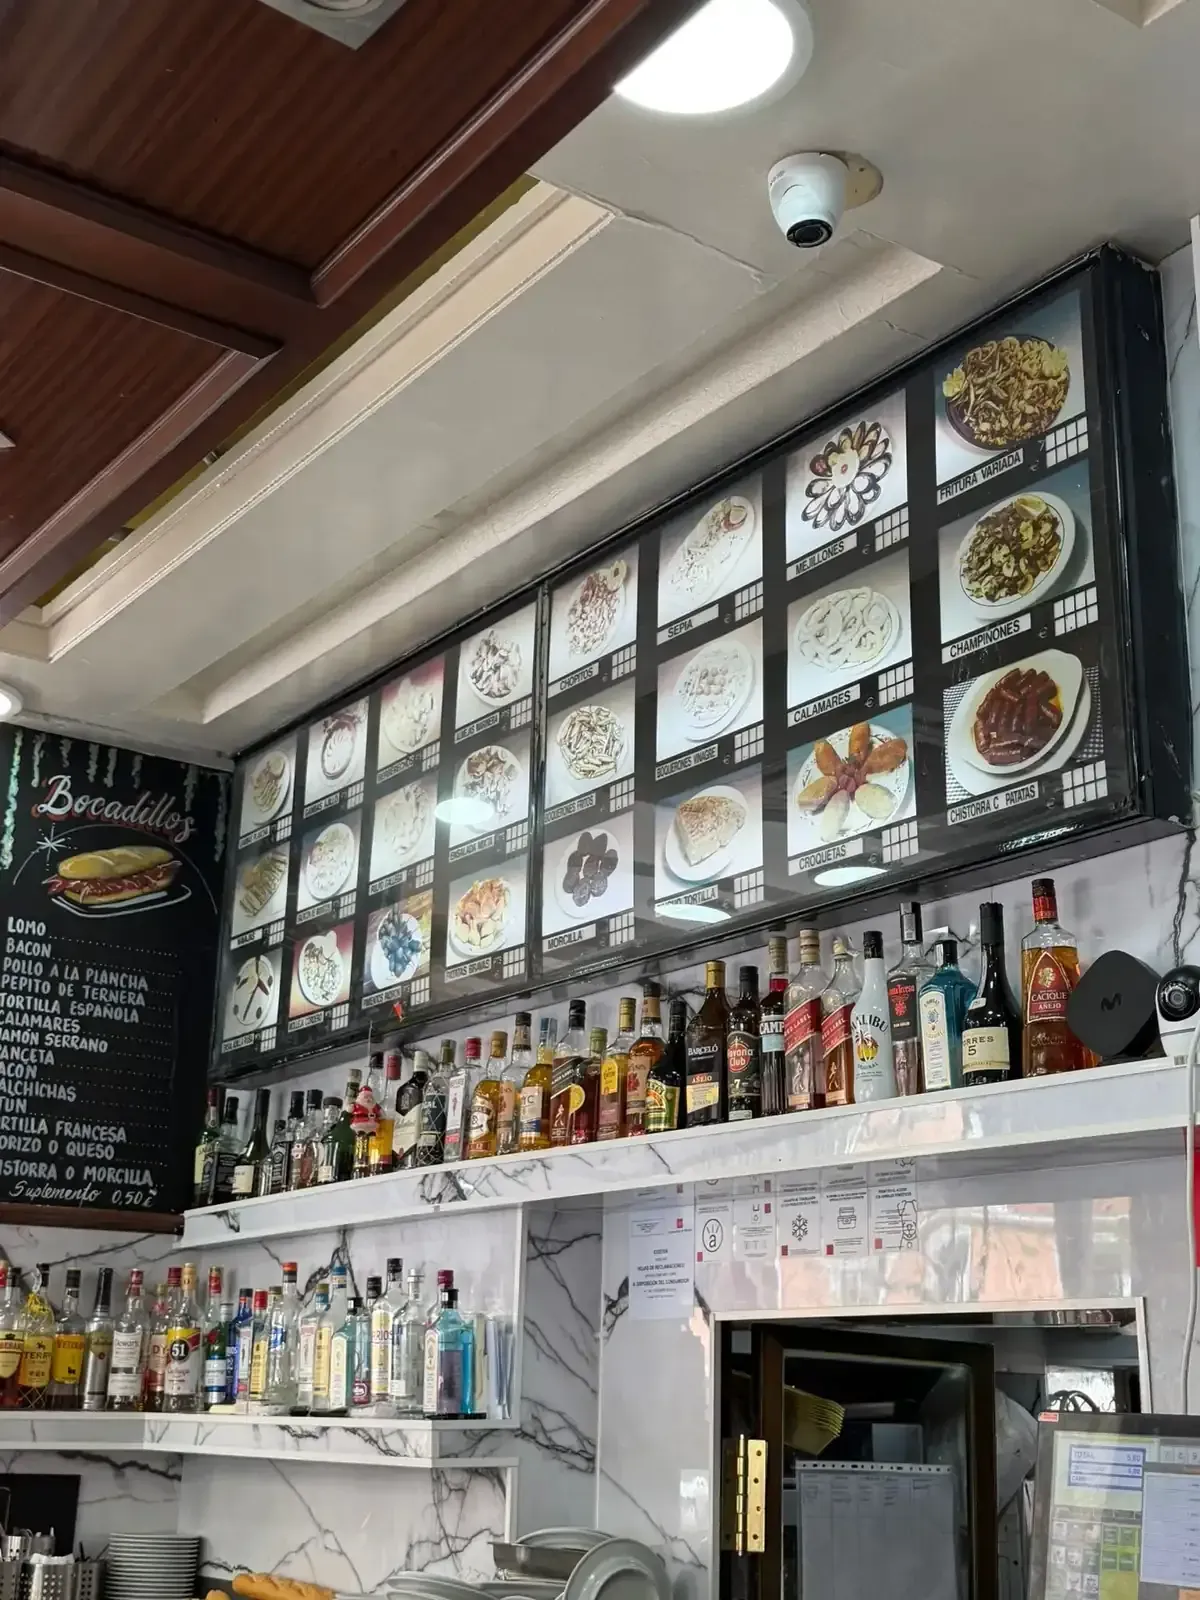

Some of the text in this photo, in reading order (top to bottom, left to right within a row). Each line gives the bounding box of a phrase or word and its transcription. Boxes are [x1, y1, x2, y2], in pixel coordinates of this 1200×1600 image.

[939, 452, 1021, 500] FRITURA VARIADA
[795, 540, 845, 575] MEJILLONES
[667, 618, 693, 638] SEPIA
[559, 667, 594, 691] CHOPITOS
[793, 690, 851, 723] CALAMARES
[37, 775, 196, 844] Bocadillos
[950, 784, 1036, 822] CHISTORRA C PATATAS
[799, 844, 847, 871] CROQUETAS
[7, 916, 46, 936] LOMO
[6, 937, 51, 958] BACON
[547, 930, 584, 950] MORCILLA
[3, 957, 148, 991] POLLO A LA PLANCHA
[1, 974, 146, 1007] PEPITO DE TERNERA
[1031, 991, 1068, 1001] CACIQUE
[0, 992, 139, 1023] TORTILLA ESPAÑOLA
[760, 1021, 784, 1035] CAMP
[0, 1044, 55, 1066] ANCETA
[44, 1033, 108, 1053] SERRANO
[688, 1043, 719, 1056] BARCELÓ
[968, 1045, 977, 1056] 5
[729, 1057, 746, 1066] Club
[0, 1077, 77, 1102] ALCHICHAS
[734, 1079, 741, 1089] 7
[0, 1115, 127, 1143] RTILLA FRANCESA
[0, 1135, 115, 1160] ORIZO O QUESO
[0, 1158, 153, 1188] ISTORRA O MORCILLA
[9, 1180, 101, 1208] Suplemento
[153, 1345, 167, 1354] DY
[171, 1343, 186, 1357] 51
